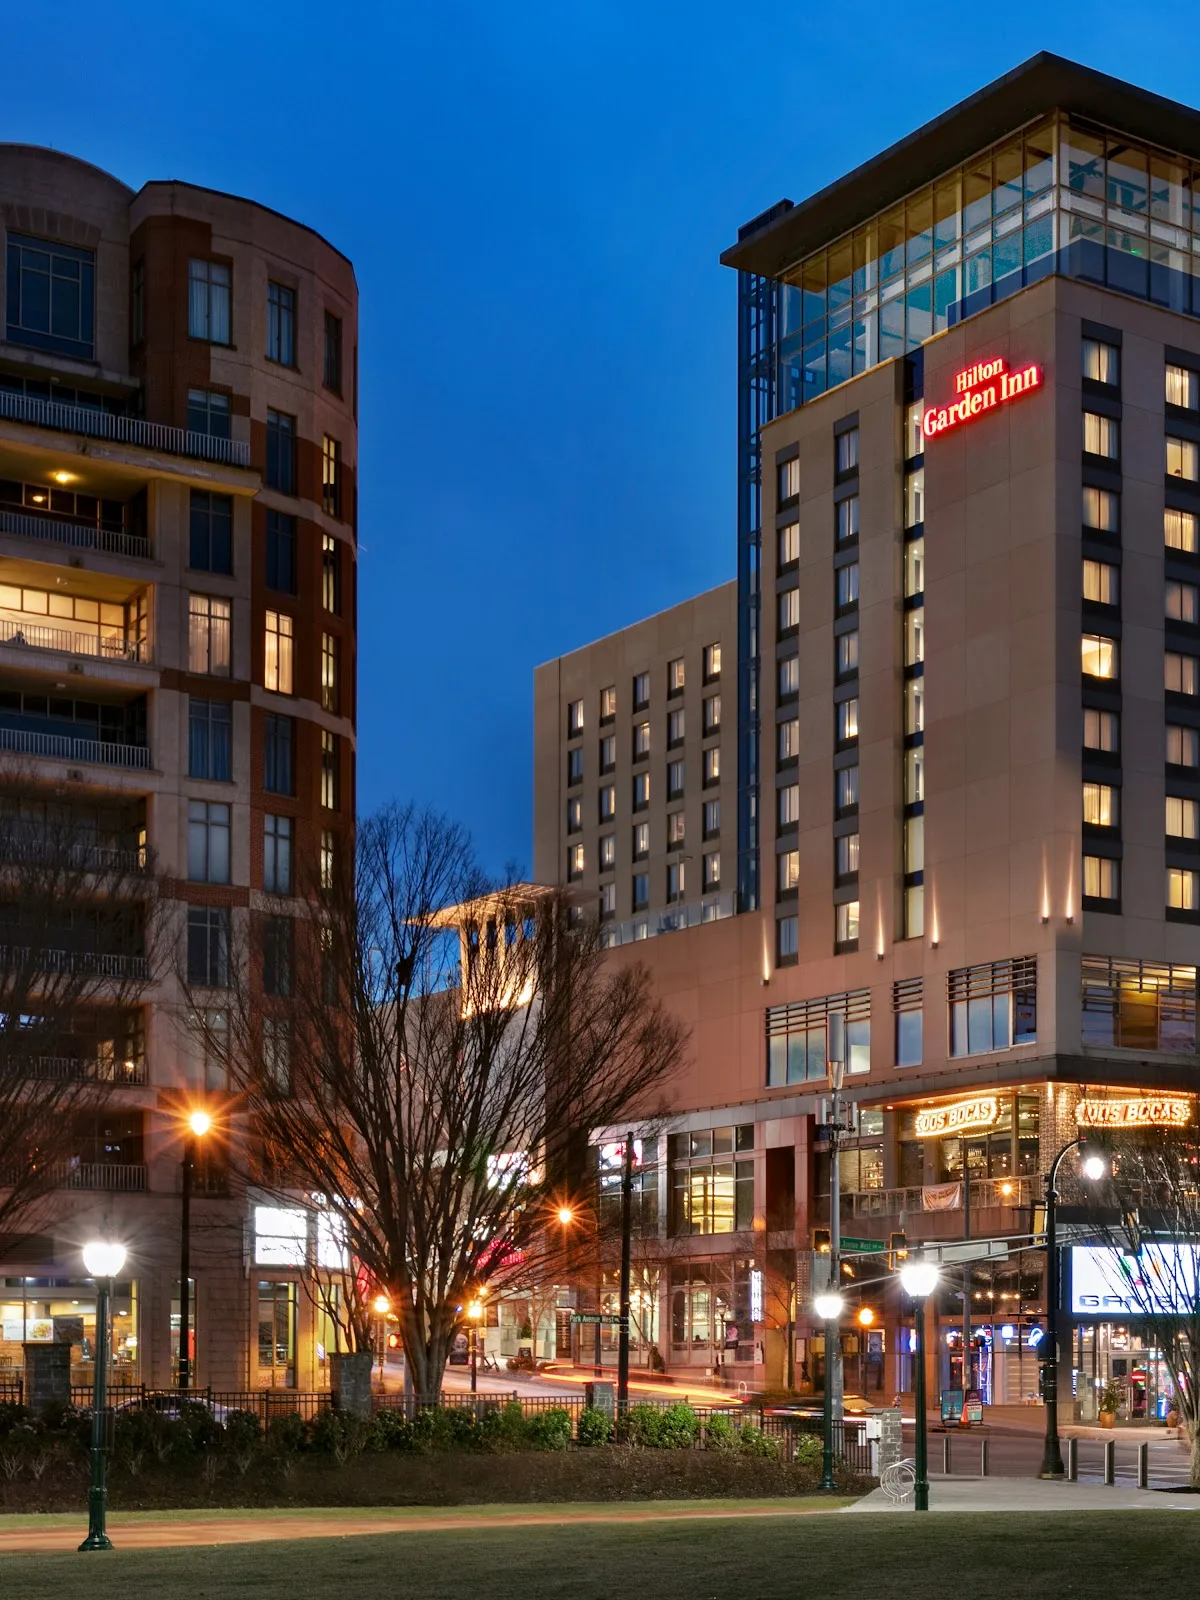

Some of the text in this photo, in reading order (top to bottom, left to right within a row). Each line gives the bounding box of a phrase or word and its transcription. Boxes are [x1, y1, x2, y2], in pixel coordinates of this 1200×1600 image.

[955, 358, 1004, 394] Hilton
[923, 365, 1039, 436] Garden Inn
[948, 1102, 990, 1127] BOCAS
[1125, 1102, 1184, 1122] BOCAS
[570, 1315, 582, 1323] Park
[582, 1315, 600, 1324] Avenue
[601, 1315, 614, 1324] West
